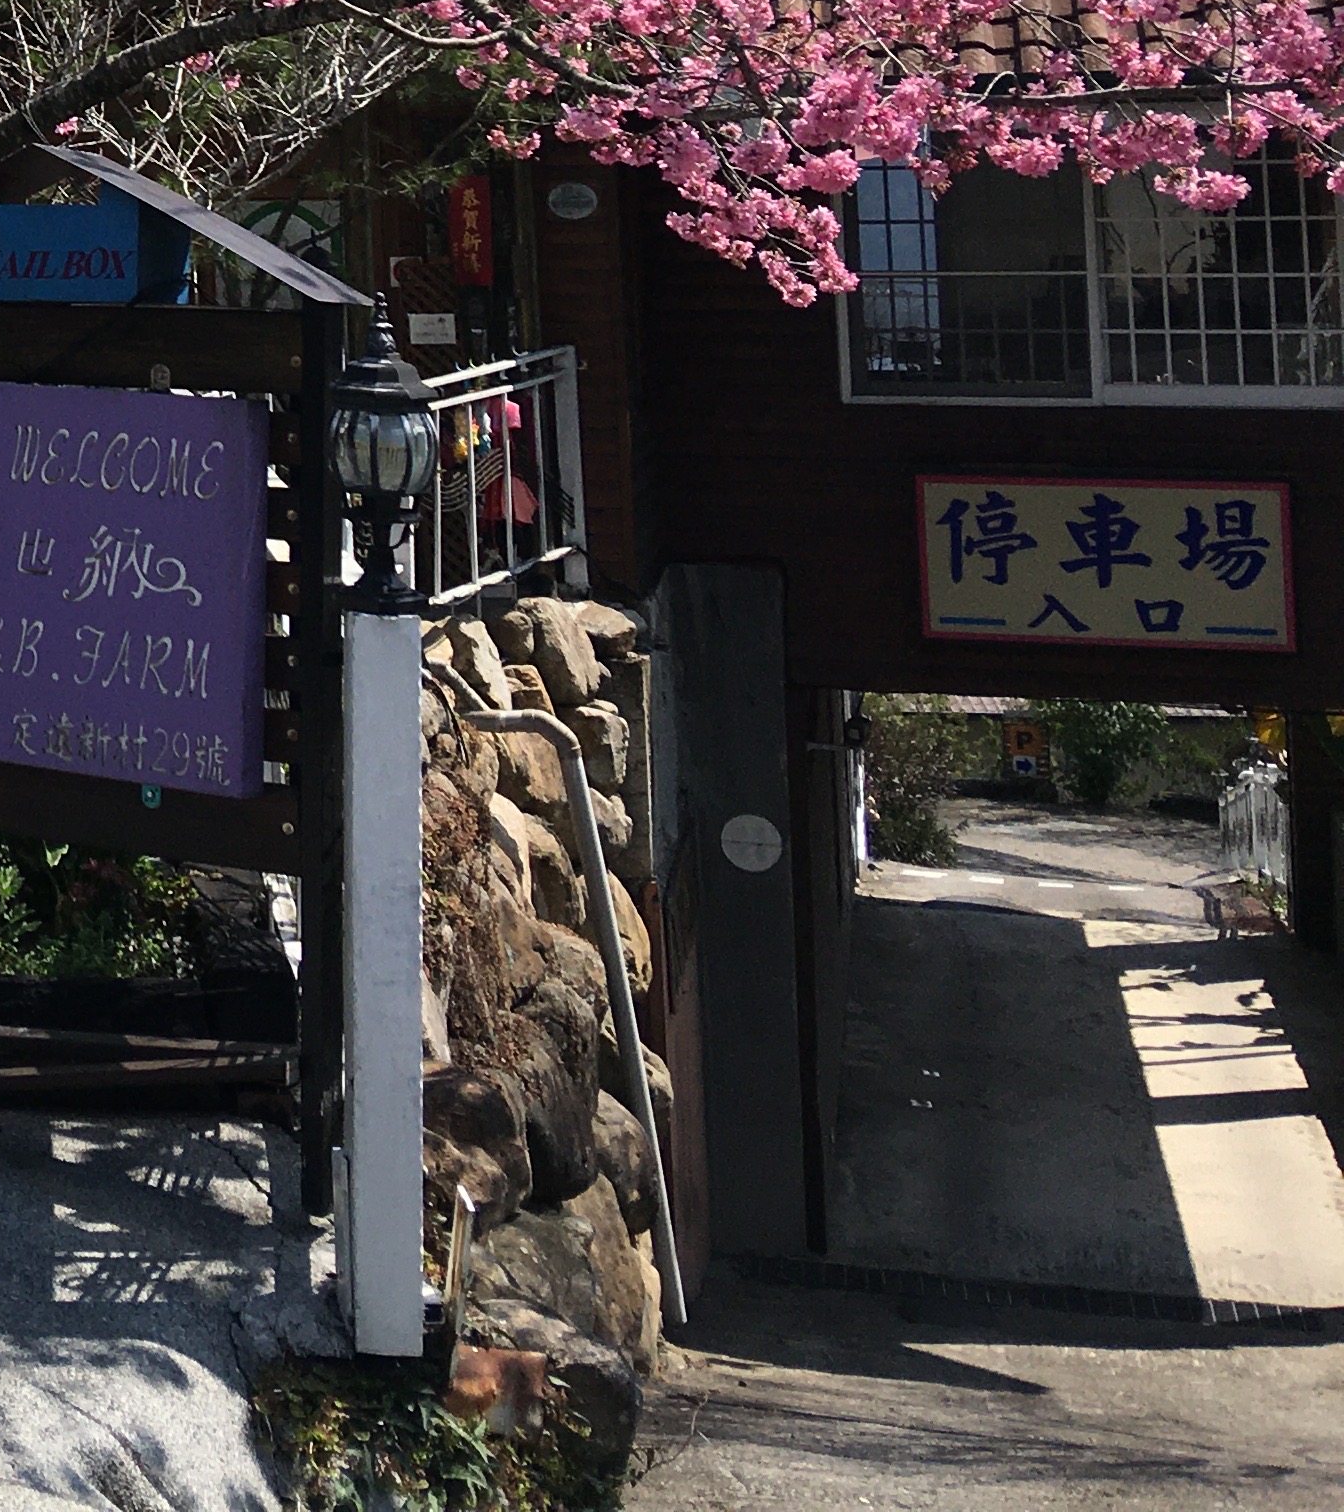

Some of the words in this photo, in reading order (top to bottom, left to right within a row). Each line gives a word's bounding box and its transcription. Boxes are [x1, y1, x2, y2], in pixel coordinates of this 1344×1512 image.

[10, 424, 224, 499] WELCOME
[935, 490, 1271, 590] 停車場
[1027, 593, 1185, 633] 入口
[1016, 731, 1034, 750] P
